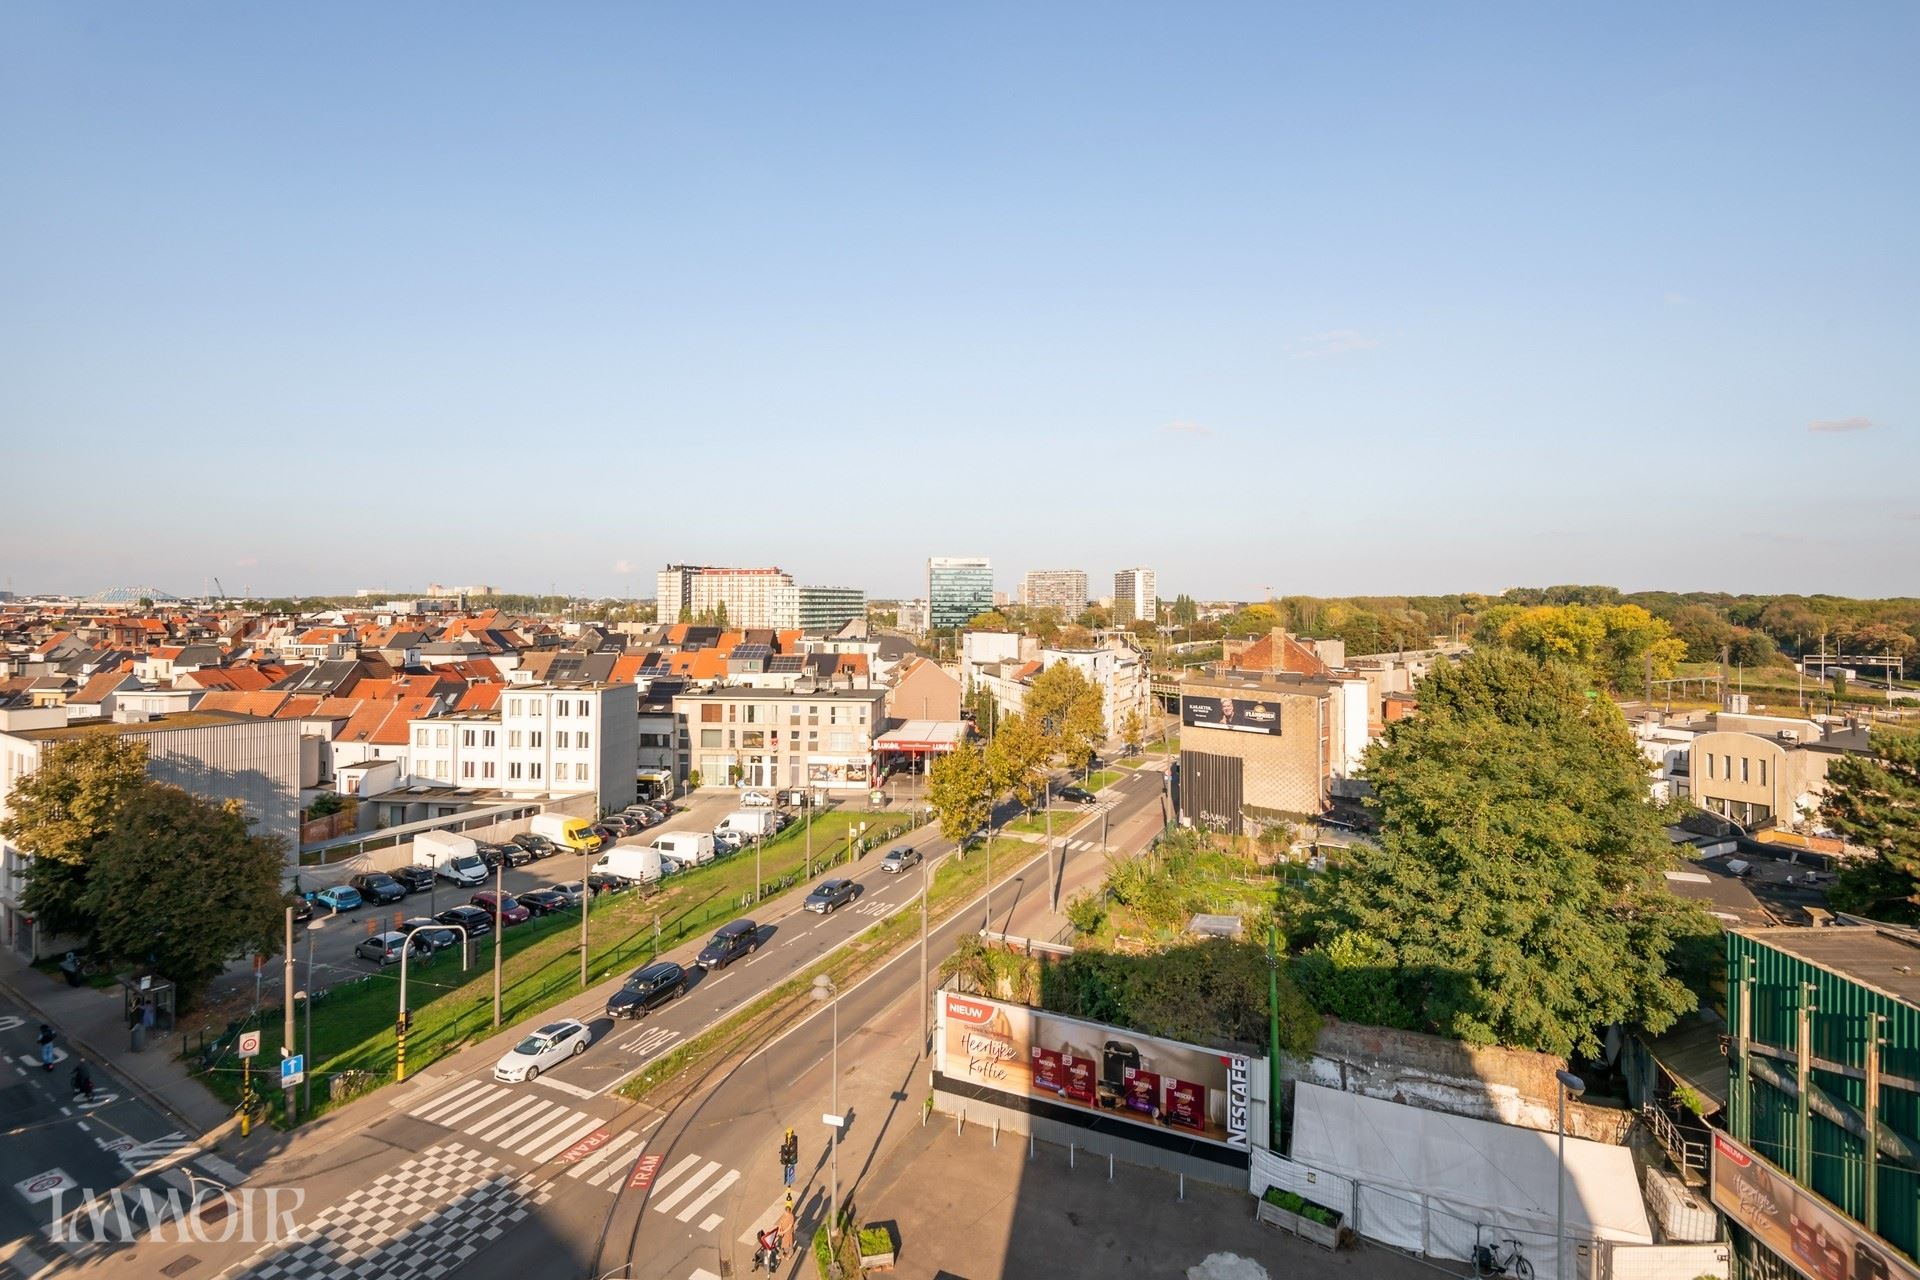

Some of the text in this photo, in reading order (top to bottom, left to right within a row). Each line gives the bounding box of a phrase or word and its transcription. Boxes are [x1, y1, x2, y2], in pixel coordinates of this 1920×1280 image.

[948, 1003, 983, 1019] NIEUW
[619, 1026, 680, 1056] BUS
[960, 1033, 1017, 1064] Heerlijke
[968, 1055, 1008, 1081] Koffie
[563, 1132, 610, 1162] TRAM
[630, 1155, 660, 1188] TRAM
